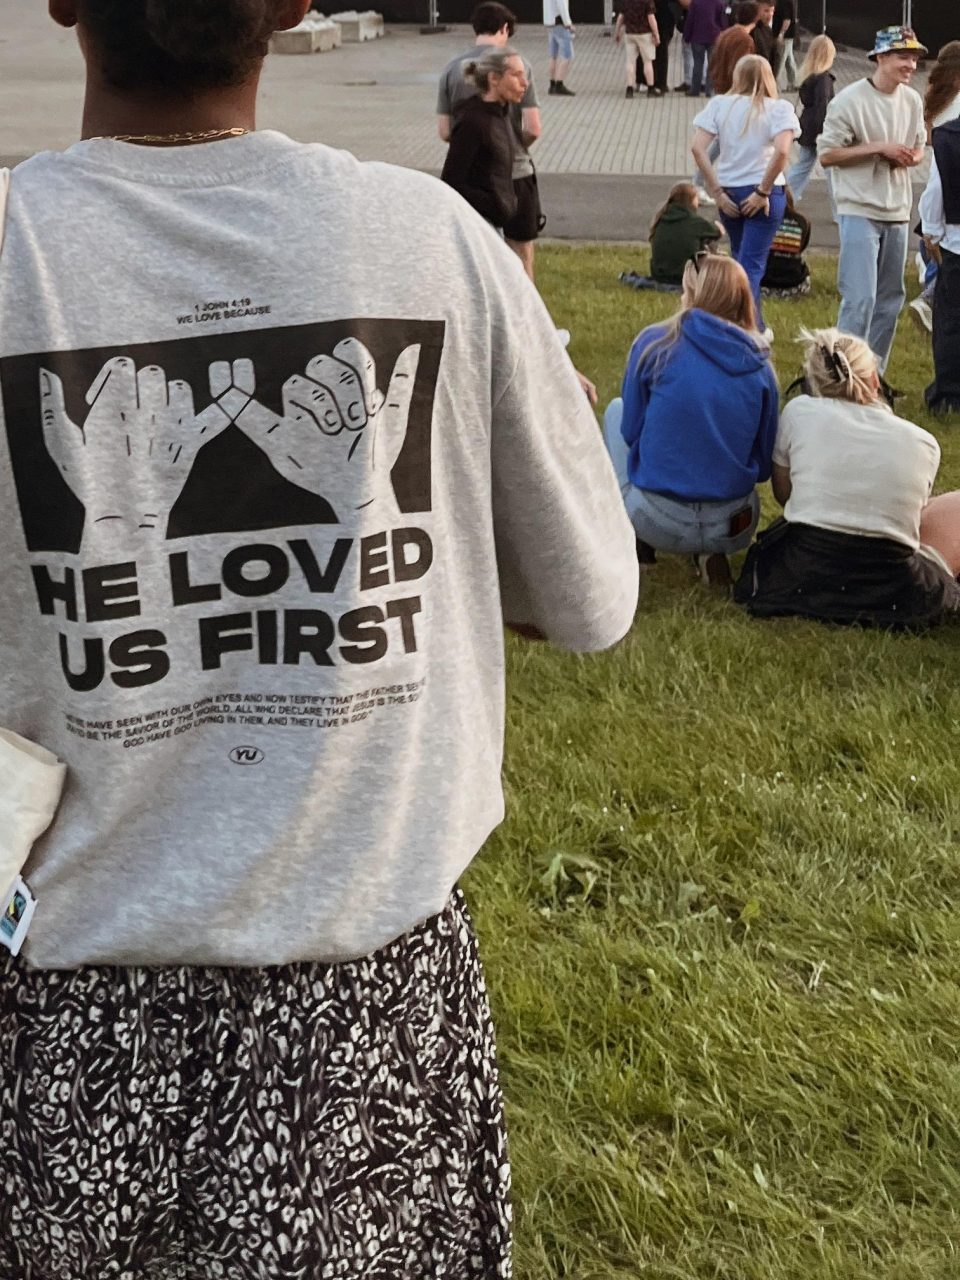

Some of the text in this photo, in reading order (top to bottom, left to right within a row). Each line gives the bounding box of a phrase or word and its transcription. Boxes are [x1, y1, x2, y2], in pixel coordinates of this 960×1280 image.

[176, 305, 271, 324] WE LOVE BECAUSE
[202, 301, 229, 312] JOHN
[30, 526, 433, 622] HE LOVED
[58, 595, 422, 692] US FIRST
[87, 720, 113, 730] HAVE
[117, 715, 142, 728] SEEN
[145, 709, 168, 721] WITH
[171, 704, 191, 716] OUR
[215, 693, 242, 703] EYES
[243, 693, 263, 703] AND
[265, 694, 287, 704] NOW
[290, 695, 326, 705] TESTIFY
[328, 694, 354, 705] THAT
[355, 690, 369, 700] THE
[370, 684, 404, 696] FATHER
[100, 730, 122, 741] THE
[125, 721, 160, 737] SAVIOR
[162, 718, 175, 728] OF
[177, 711, 194, 723] THE
[235, 704, 253, 714] ALL
[255, 705, 276, 714] WHO
[279, 705, 323, 716] DECLARE
[325, 705, 350, 716] THAT
[352, 699, 375, 713] JESUS
[377, 697, 385, 706] IS
[387, 695, 407, 705] THE
[123, 736, 145, 748] GOD
[145, 729, 172, 742] HAVE
[173, 722, 193, 735] GOD
[193, 715, 224, 727] LIVING
[227, 715, 236, 724] IN
[267, 716, 288, 726] AND
[290, 716, 314, 727] THEY
[317, 718, 339, 728] LIVE
